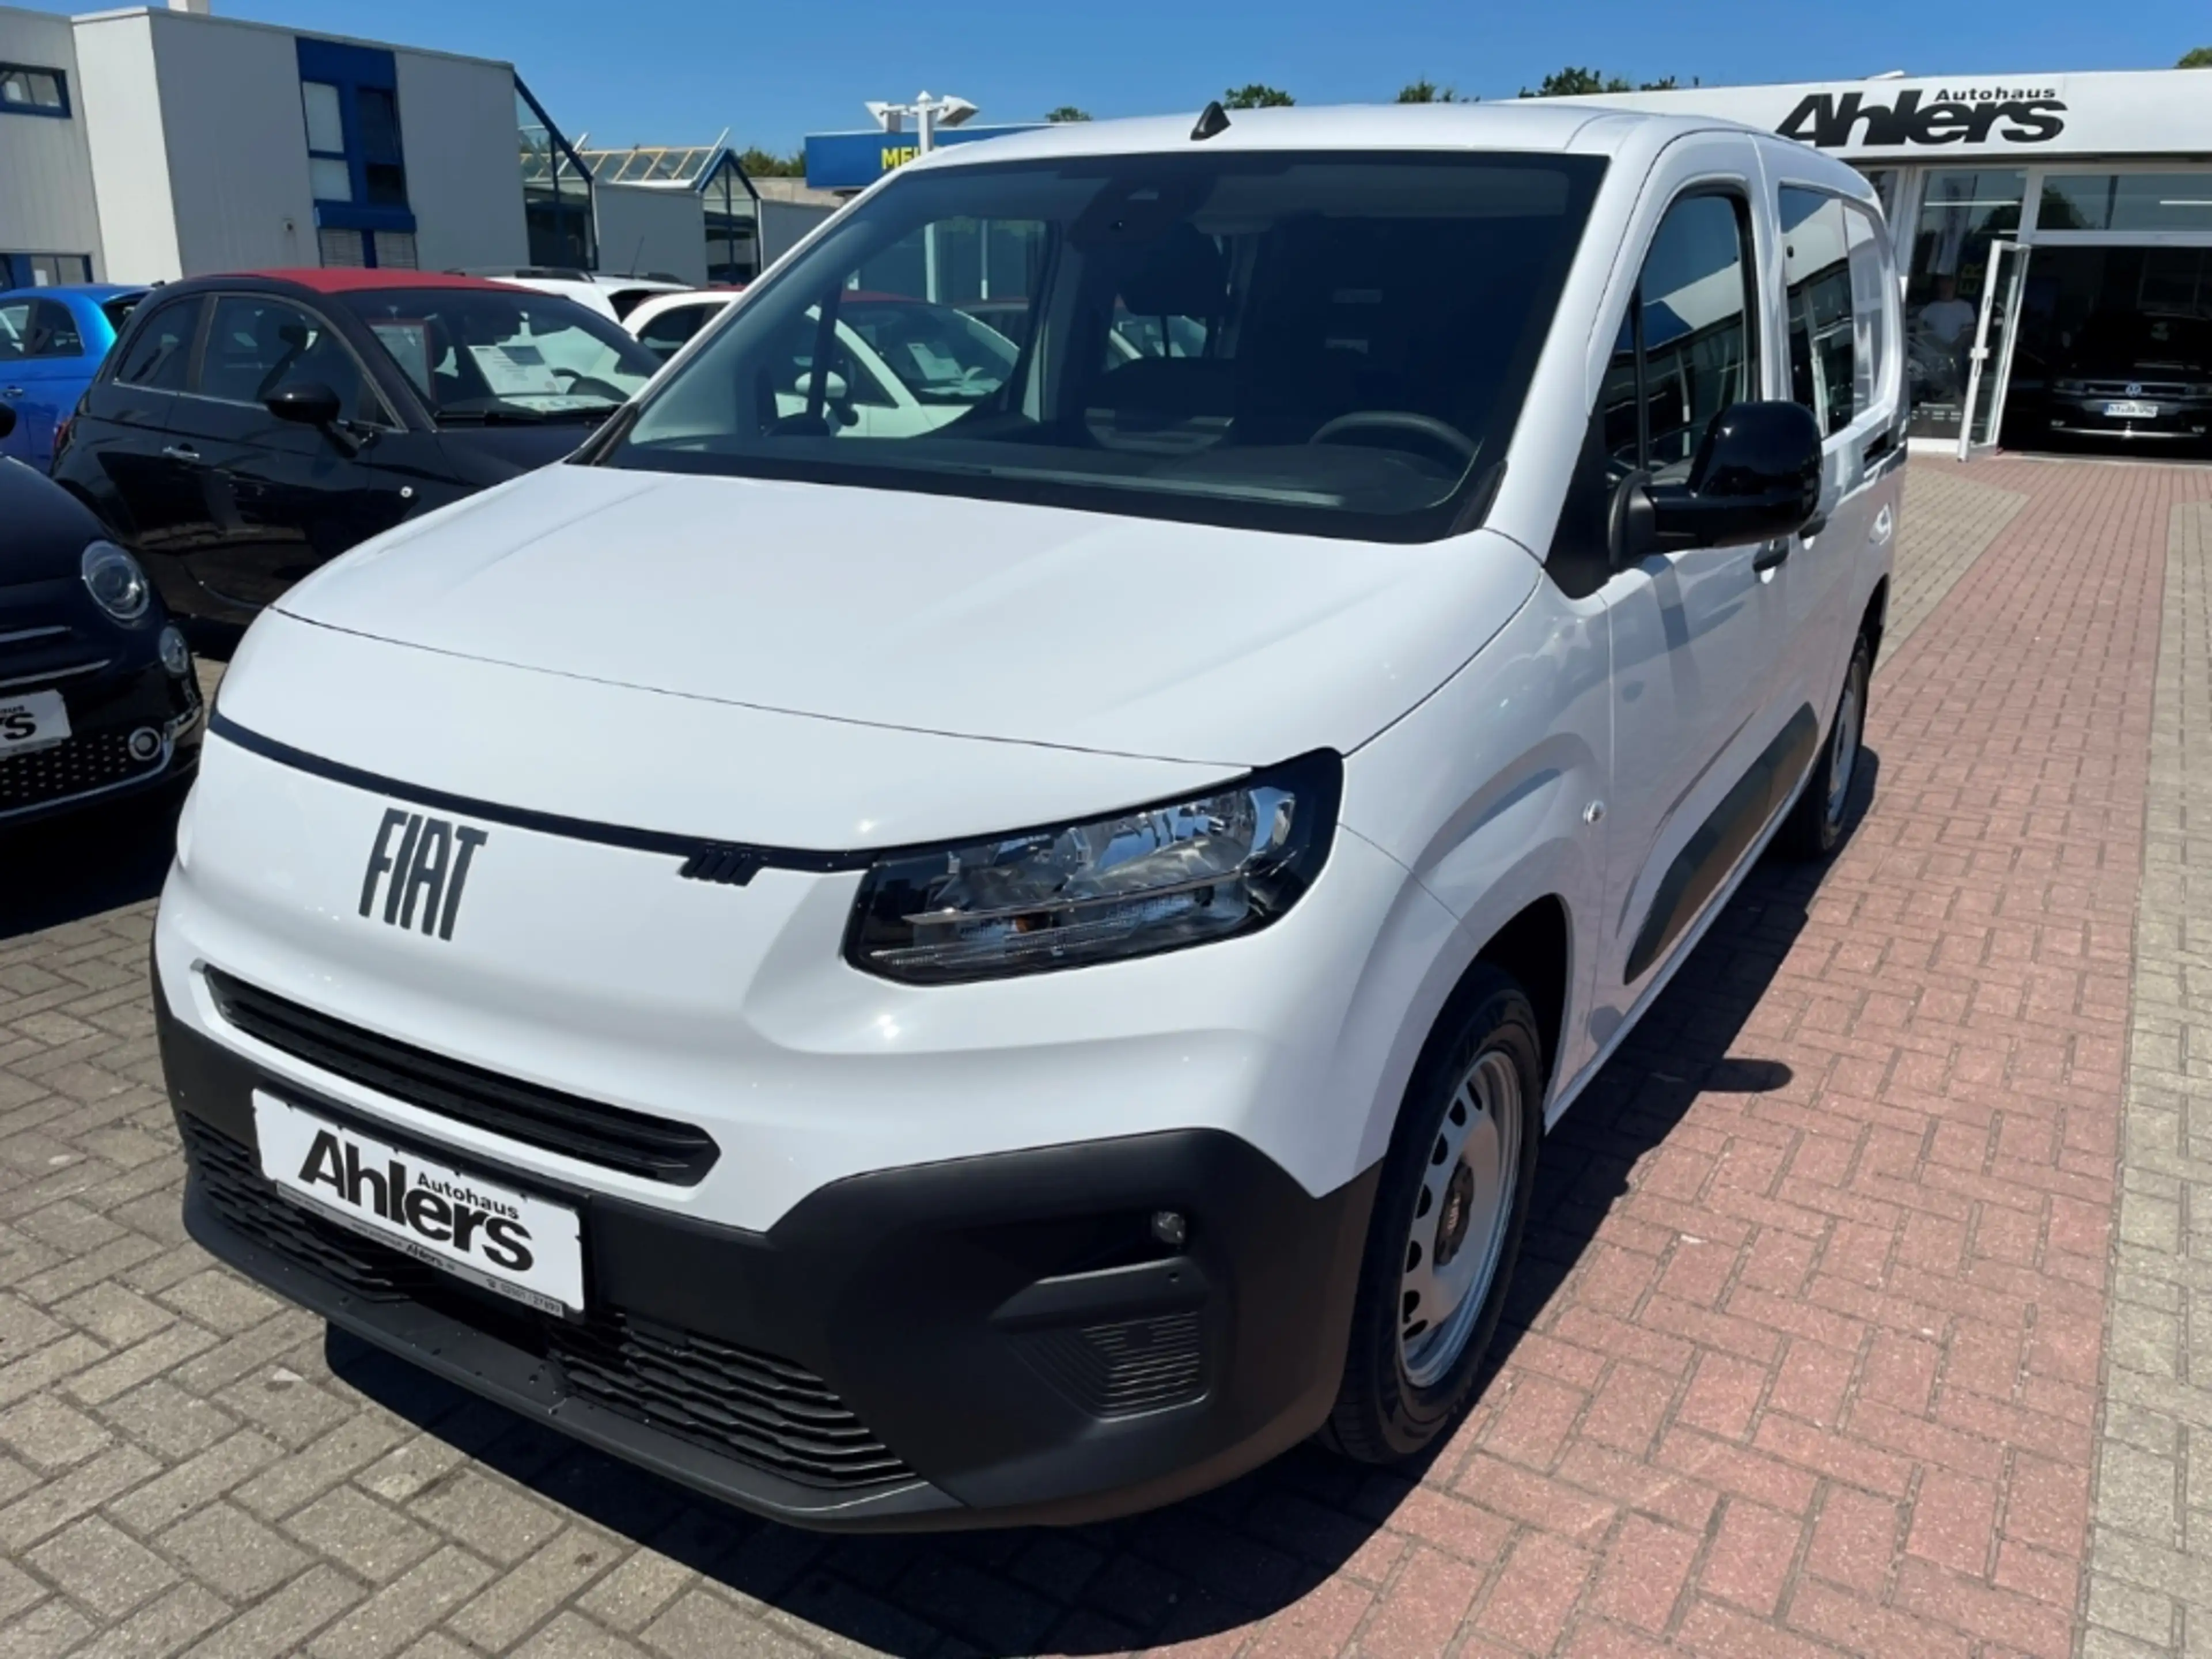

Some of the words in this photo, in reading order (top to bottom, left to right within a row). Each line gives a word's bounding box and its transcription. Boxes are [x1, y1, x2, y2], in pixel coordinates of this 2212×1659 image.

[1775, 89, 2068, 147] Ahlers
[1933, 86, 2056, 102] Autohaus
[358, 806, 490, 942] FIAT
[298, 1128, 534, 1271] Ahlers
[417, 1172, 520, 1220] Autohaus
